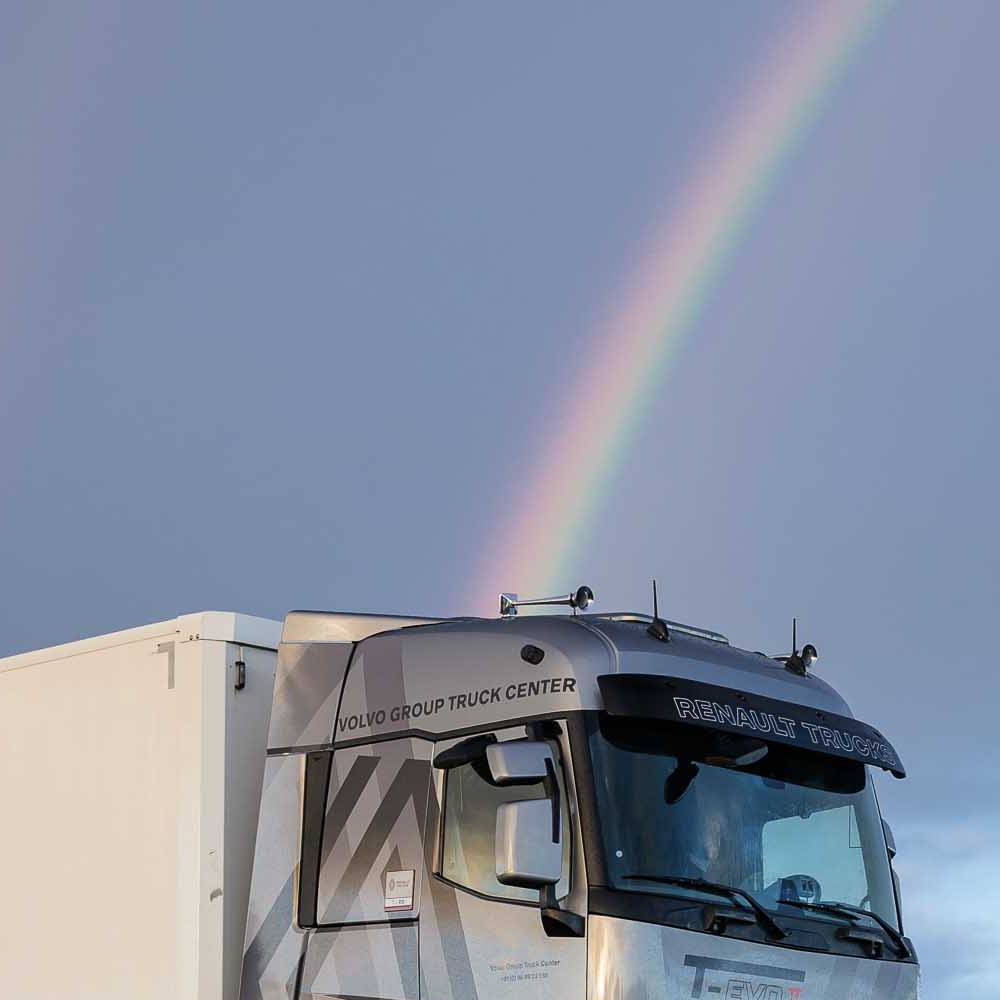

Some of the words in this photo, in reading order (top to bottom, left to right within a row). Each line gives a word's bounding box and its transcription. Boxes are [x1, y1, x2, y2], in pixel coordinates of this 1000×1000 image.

[339, 710, 386, 732] VOLVO
[390, 698, 444, 722] GROUP
[448, 687, 501, 711] TRUCK
[506, 678, 577, 700] CENTER
[673, 697, 796, 739] RENAULT
[801, 721, 897, 766] TRUCKS
